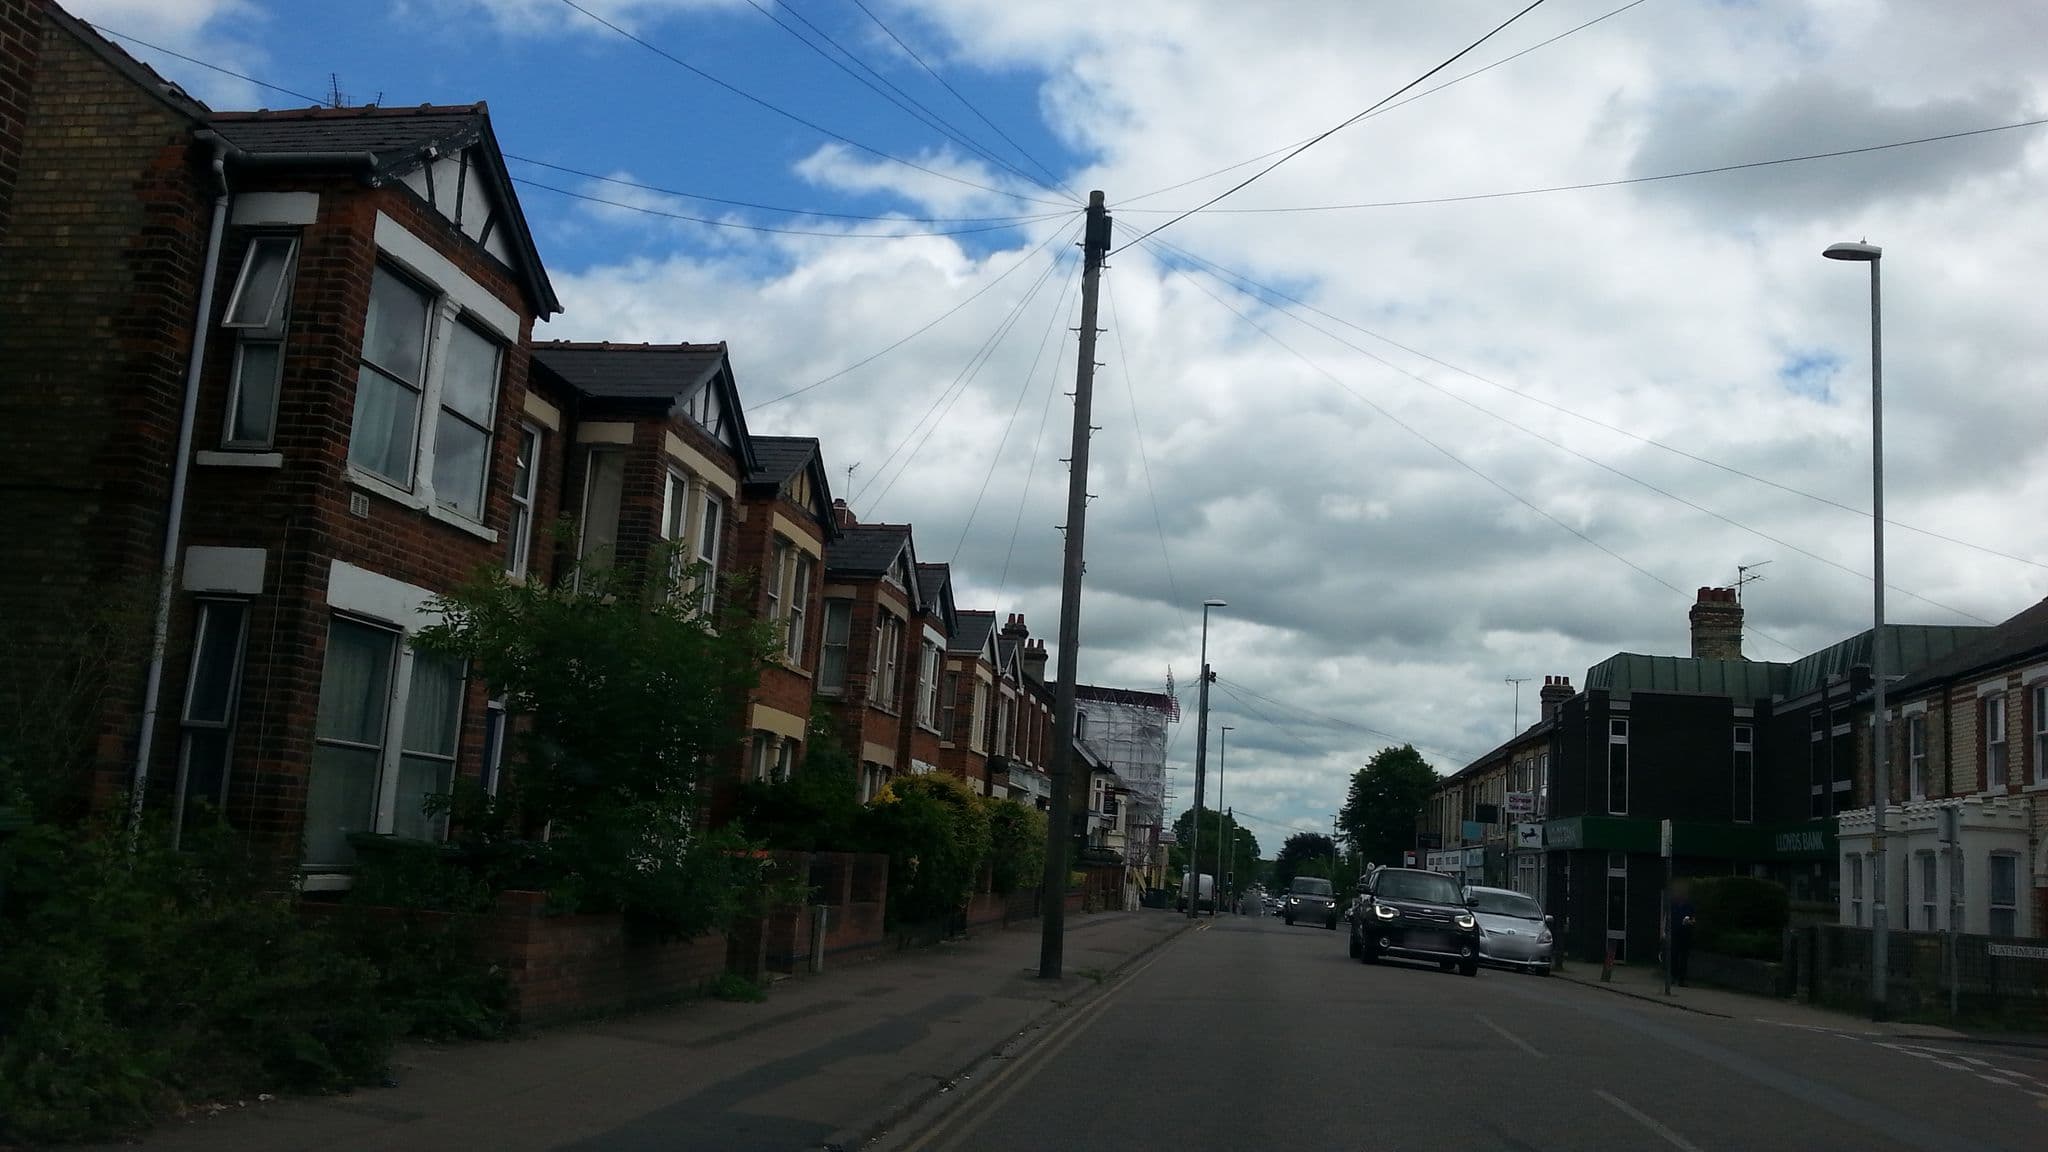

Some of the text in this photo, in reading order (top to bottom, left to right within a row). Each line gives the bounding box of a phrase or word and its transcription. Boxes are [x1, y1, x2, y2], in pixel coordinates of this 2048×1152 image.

[1509, 796, 1532, 804] Chinese
[1776, 832, 1824, 851] LLOYDS BANK
